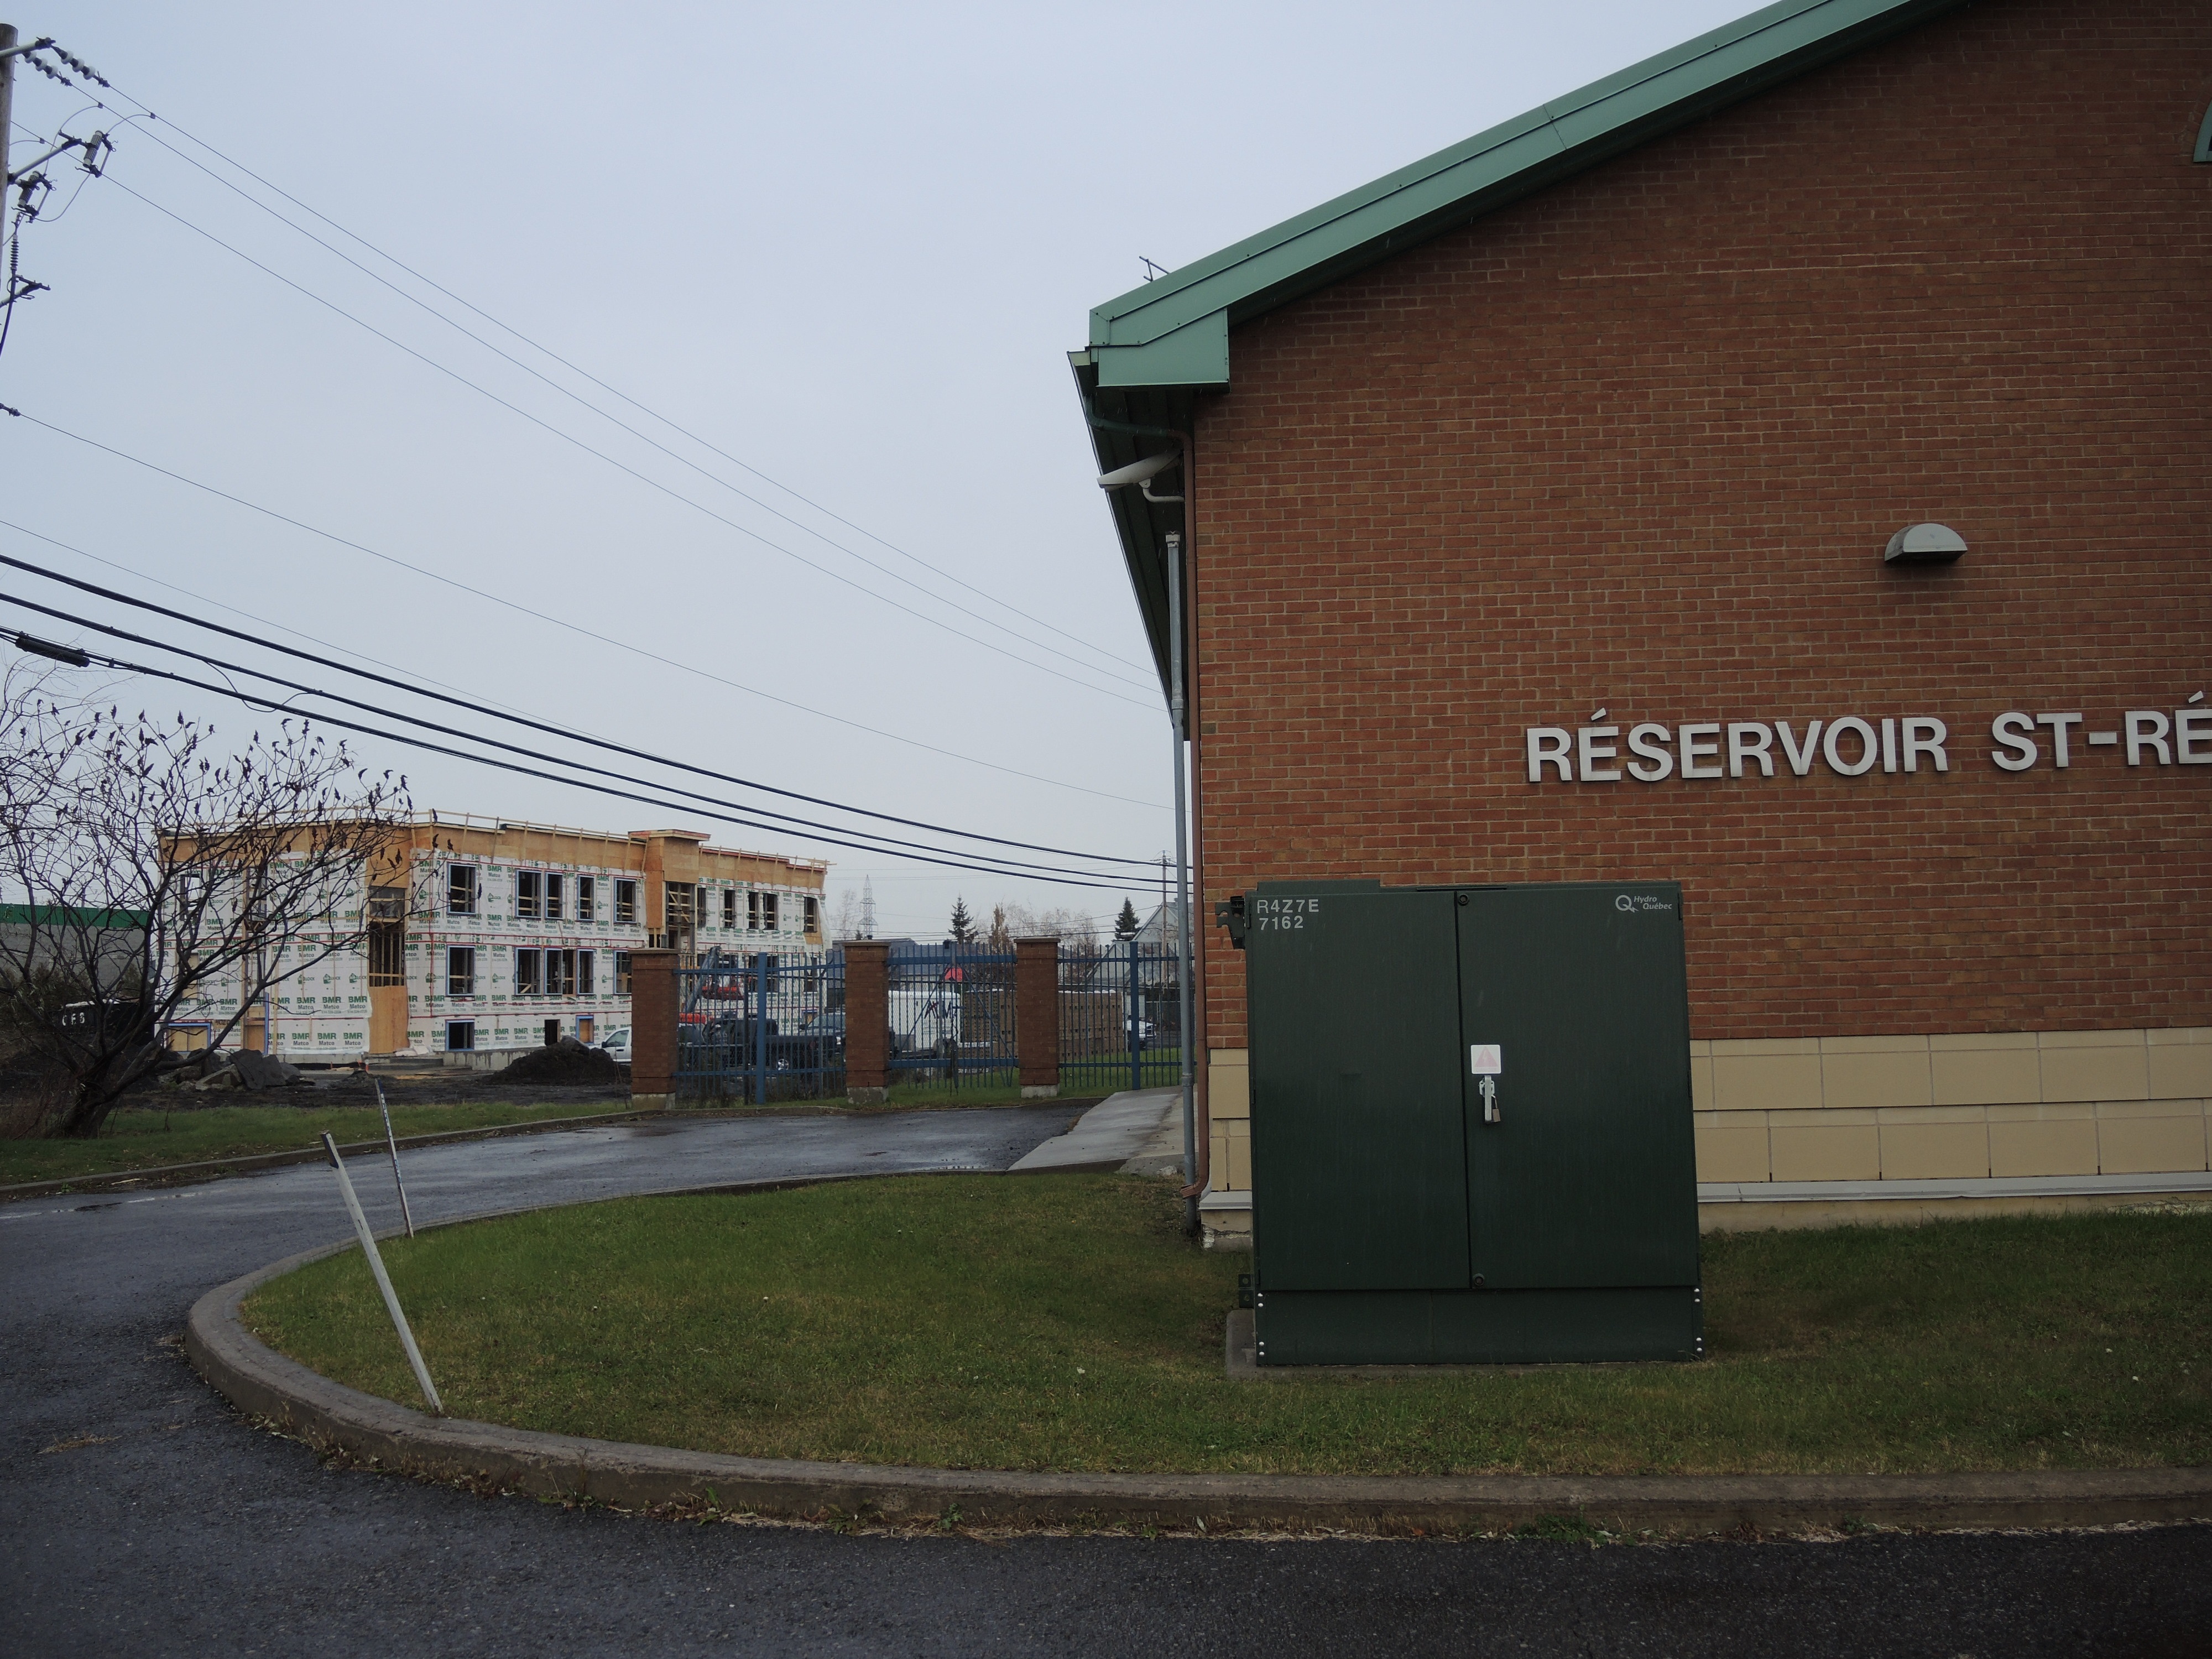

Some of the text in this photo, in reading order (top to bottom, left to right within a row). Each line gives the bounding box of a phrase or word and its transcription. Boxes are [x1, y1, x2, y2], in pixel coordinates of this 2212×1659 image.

[1526, 708, 1949, 782] RÉSERVOIR
[1257, 899, 1319, 914] R4Z7E
[1634, 895, 1657, 904] Hydro
[1259, 915, 1303, 930] 7162
